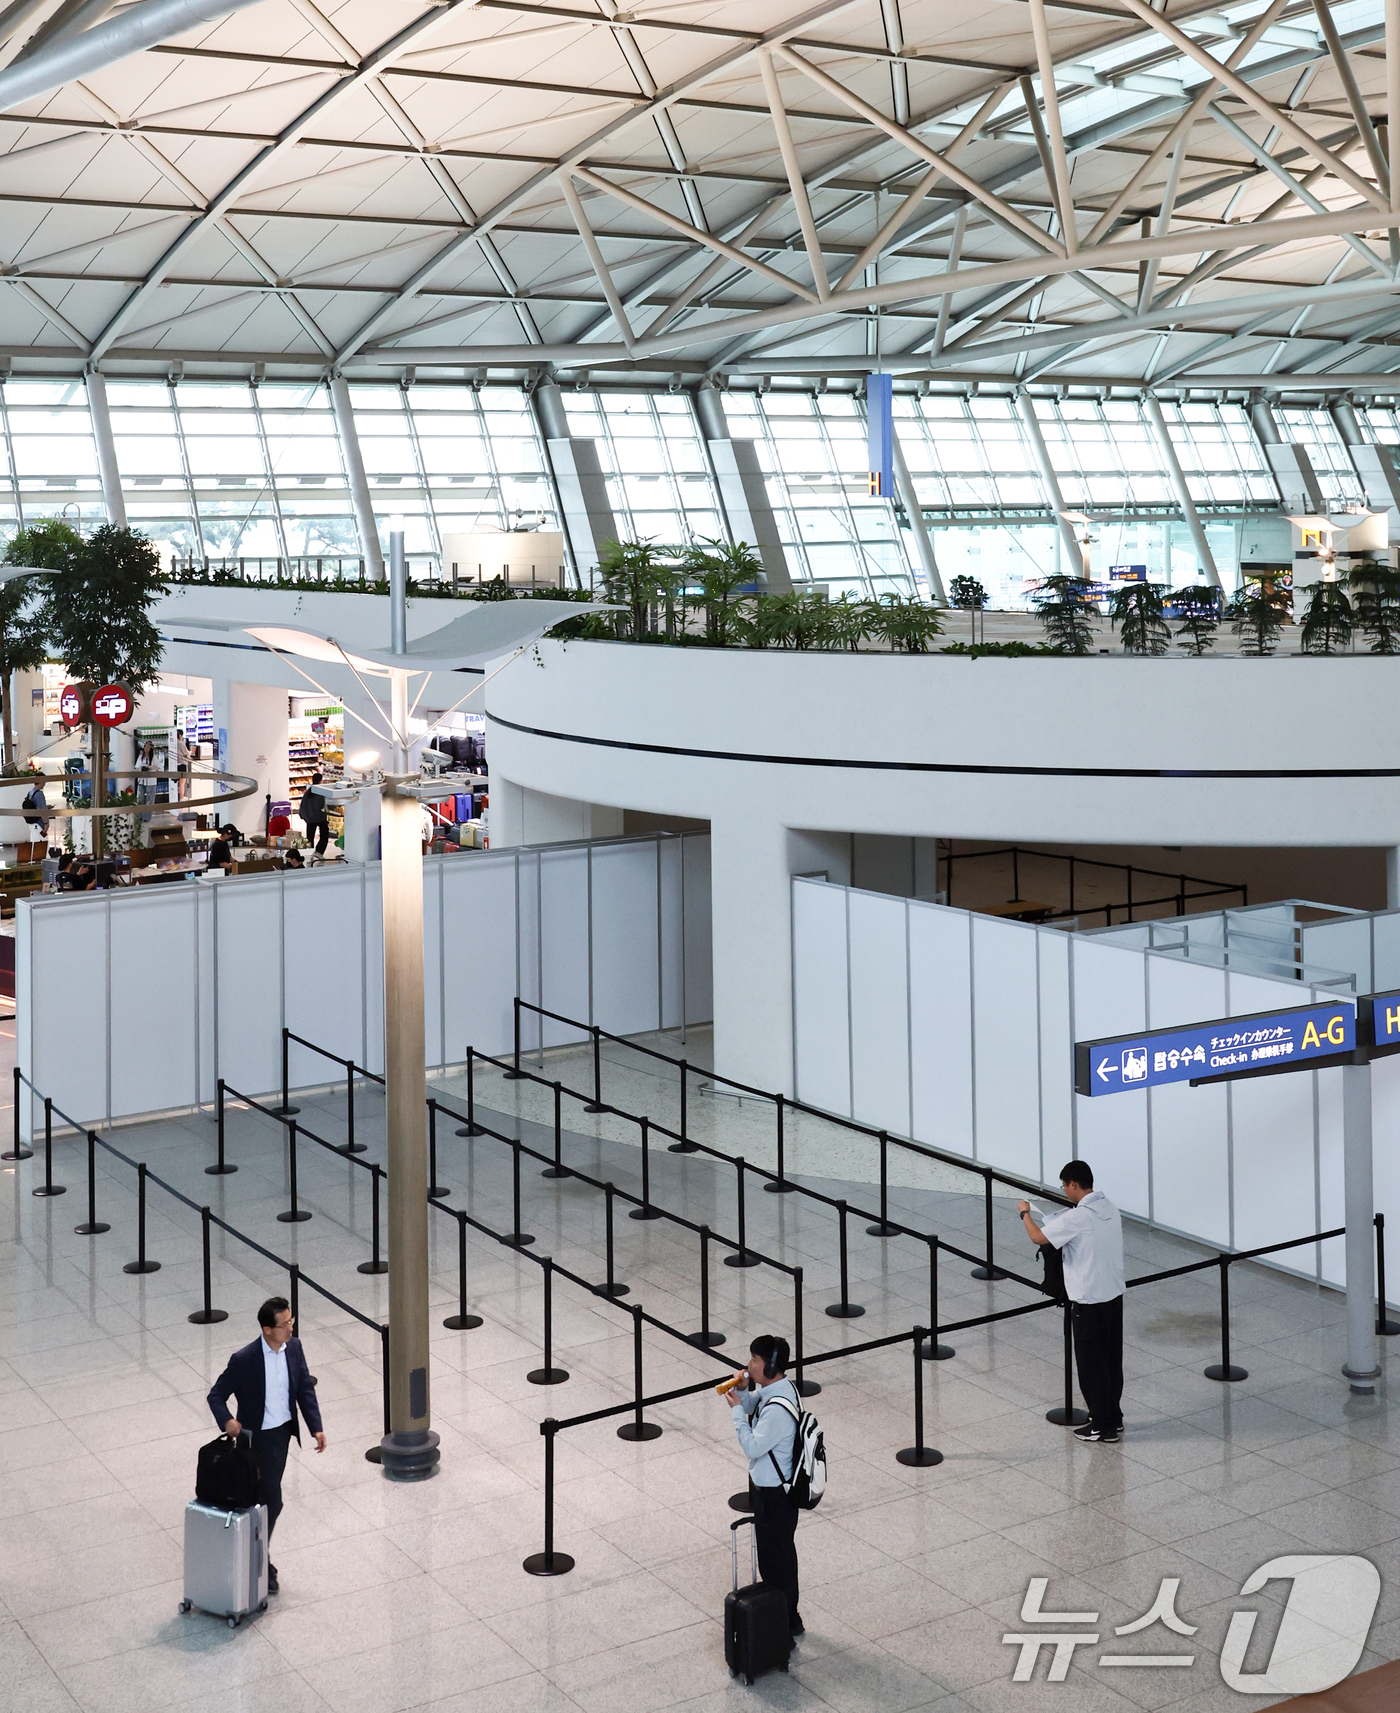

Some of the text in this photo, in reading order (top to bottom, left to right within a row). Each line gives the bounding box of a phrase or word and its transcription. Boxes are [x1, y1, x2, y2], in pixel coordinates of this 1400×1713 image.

[868, 471, 880, 496] H
[1210, 1026, 1292, 1049] チェックインカウンター
[1301, 1015, 1344, 1050] A-G
[1154, 1044, 1206, 1072] 탑승수속
[1210, 1051, 1248, 1067] Check-in
